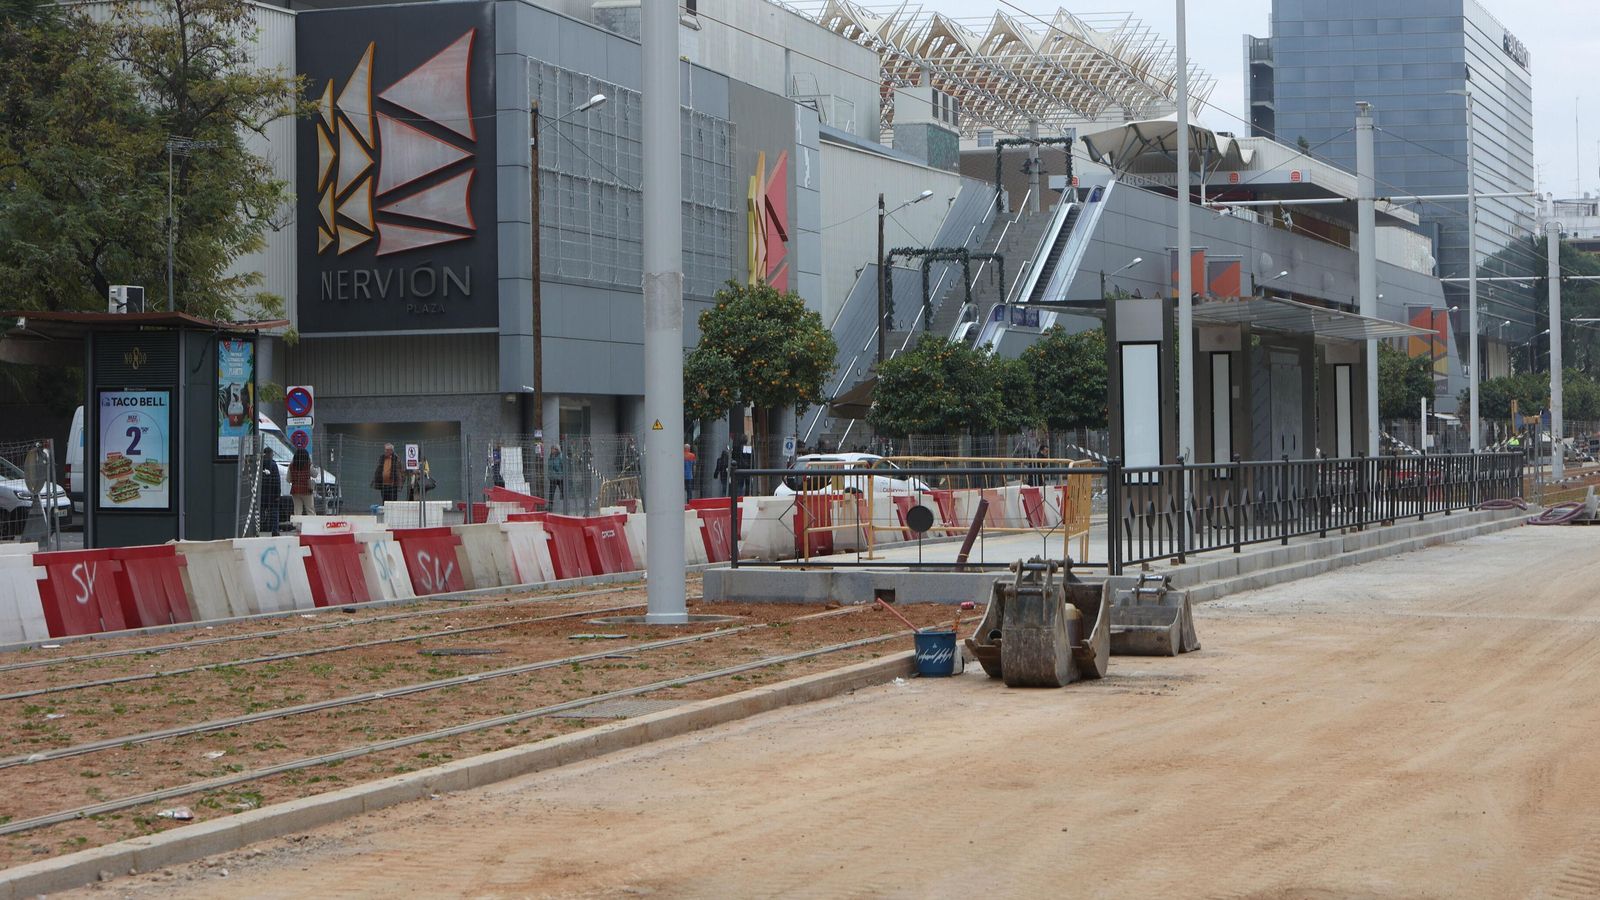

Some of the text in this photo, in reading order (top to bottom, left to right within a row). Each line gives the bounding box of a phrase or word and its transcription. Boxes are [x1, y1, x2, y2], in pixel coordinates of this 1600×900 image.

[320, 259, 472, 301] NERVIÓN
[406, 303, 447, 314] PLAZA
[111, 396, 165, 407] TACO BELL
[125, 426, 142, 456] 2
